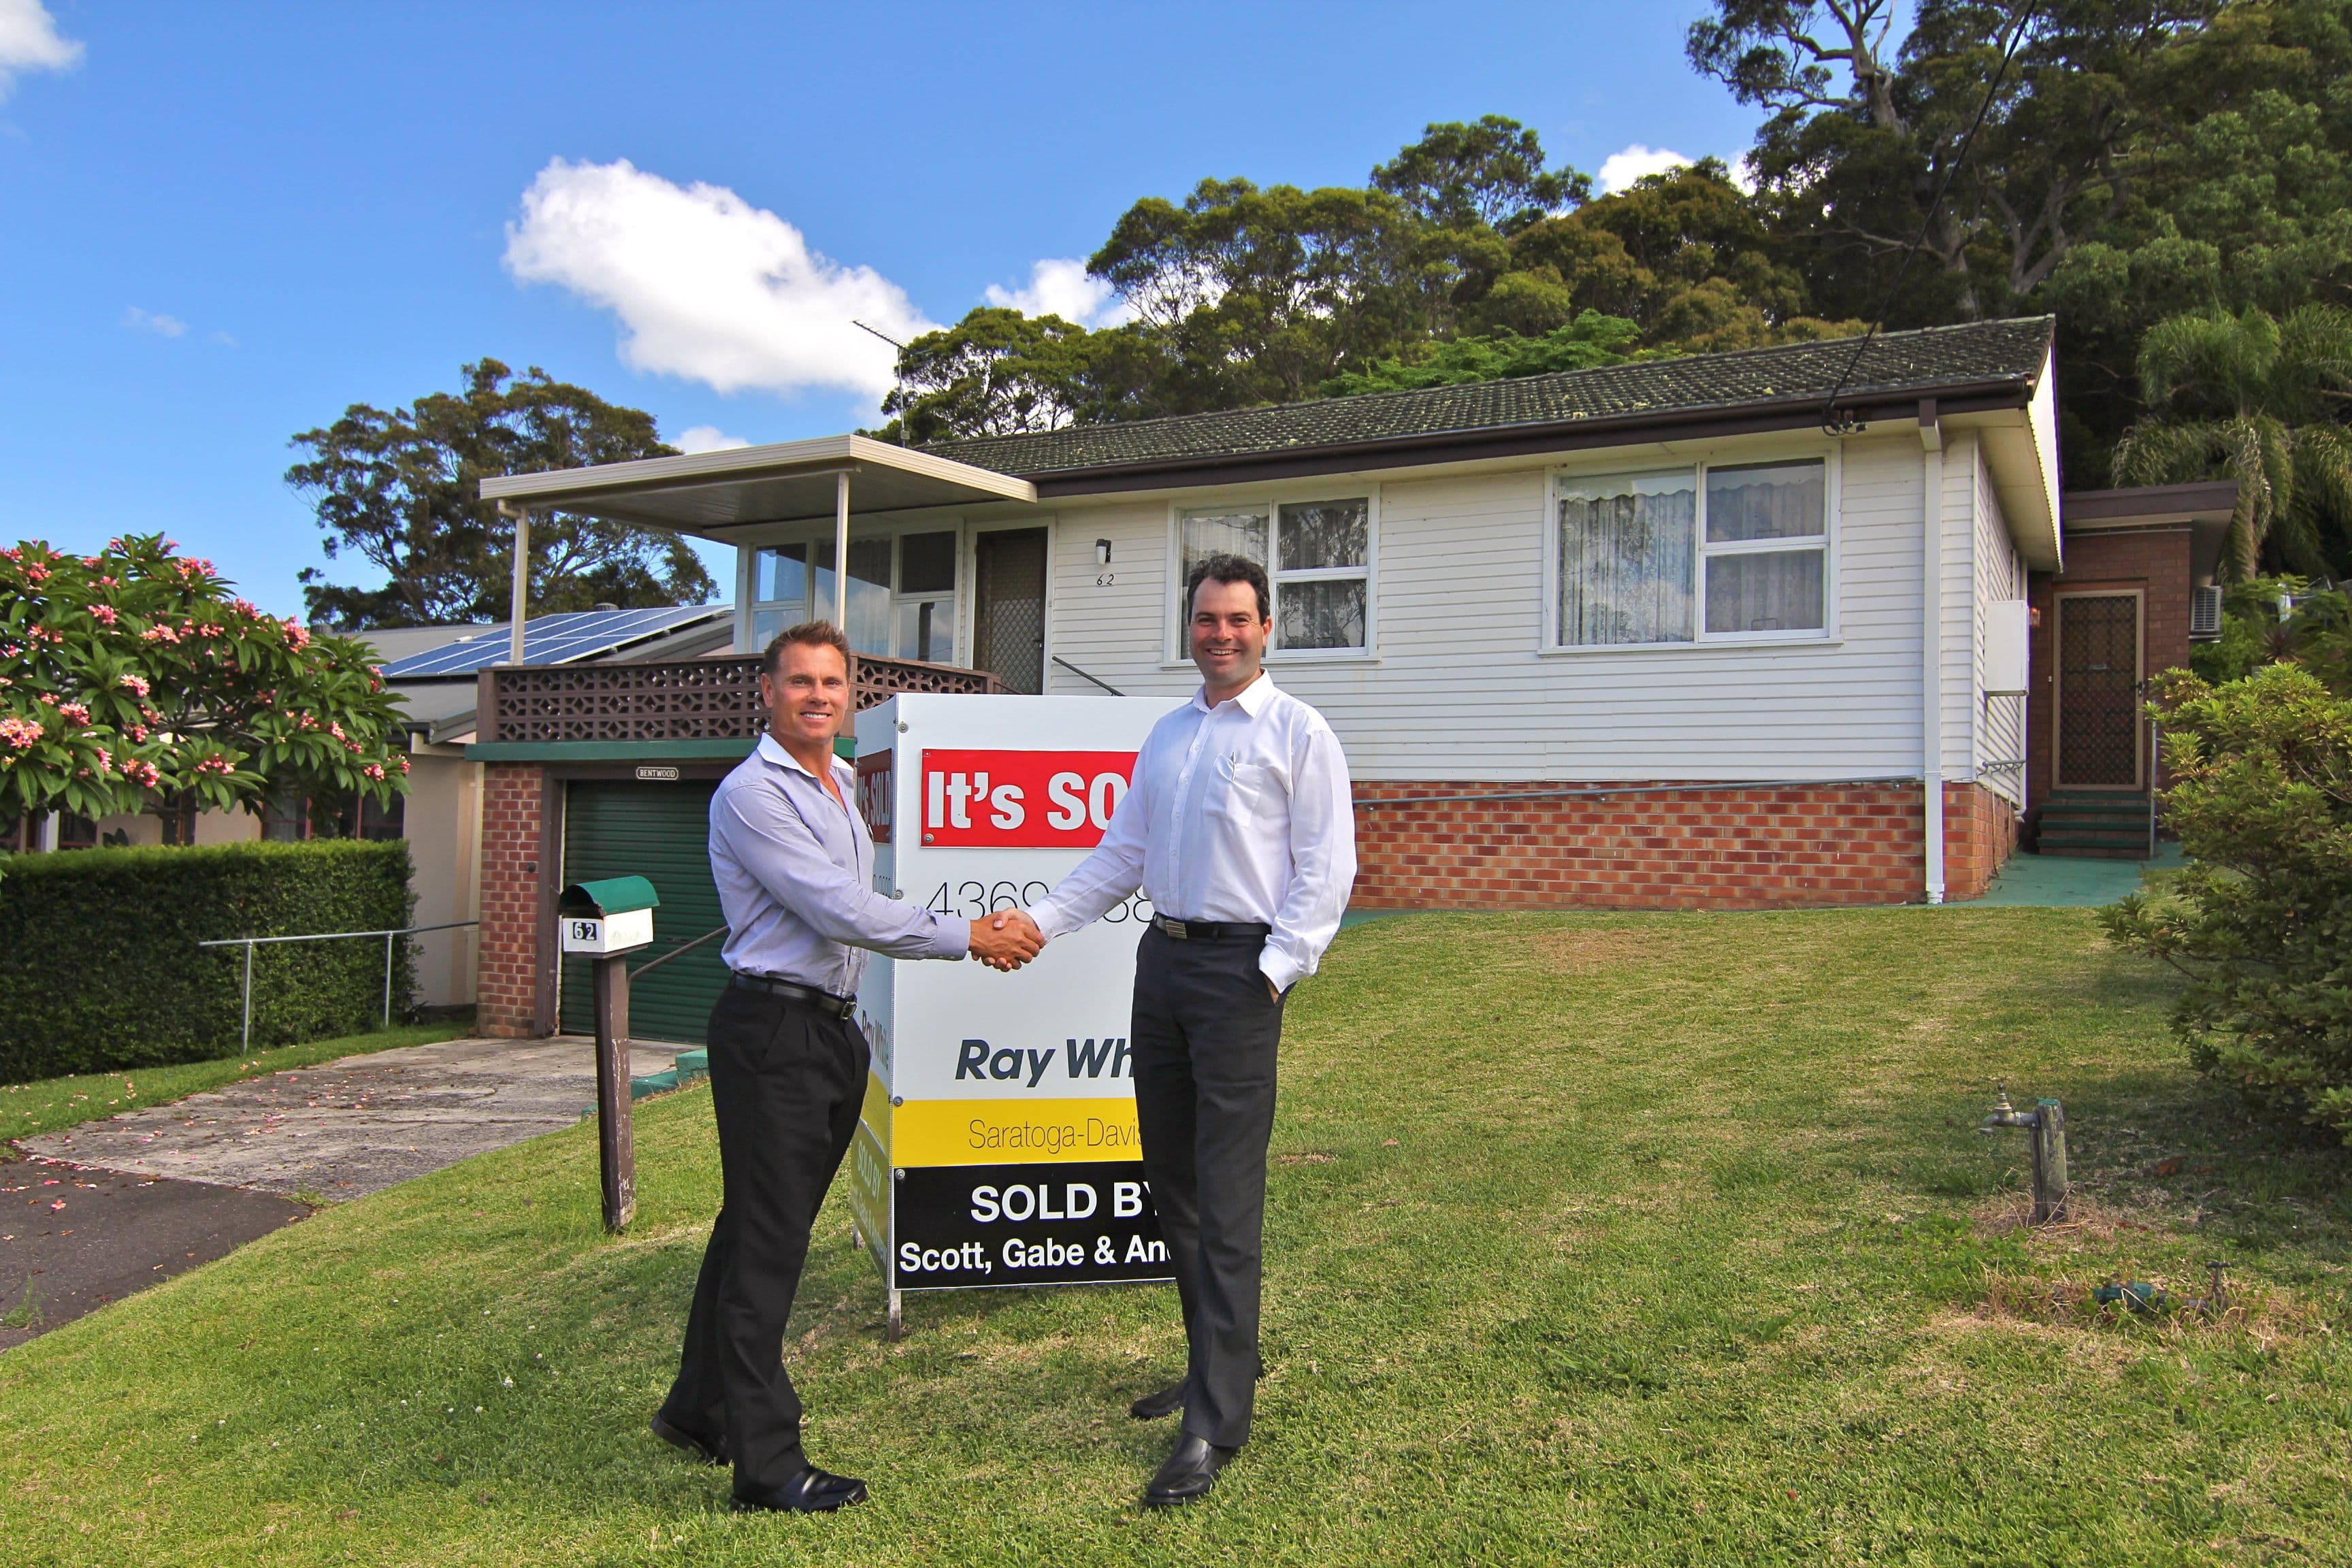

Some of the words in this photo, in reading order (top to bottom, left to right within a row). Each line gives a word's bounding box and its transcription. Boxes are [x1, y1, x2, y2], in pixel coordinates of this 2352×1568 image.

[1097, 574, 1114, 585] 62
[640, 769, 675, 777] BENTWOOD
[870, 770, 891, 826] SOLD
[928, 771, 1025, 830] It's
[573, 922, 595, 940] 62
[955, 1039, 1056, 1088] Ray
[970, 1183, 1097, 1223] SOLD
[900, 1242, 992, 1274] Scott,
[1002, 1237, 1084, 1268] Gabe
[1094, 1235, 1115, 1265] &
[1124, 1235, 1171, 1264] An
